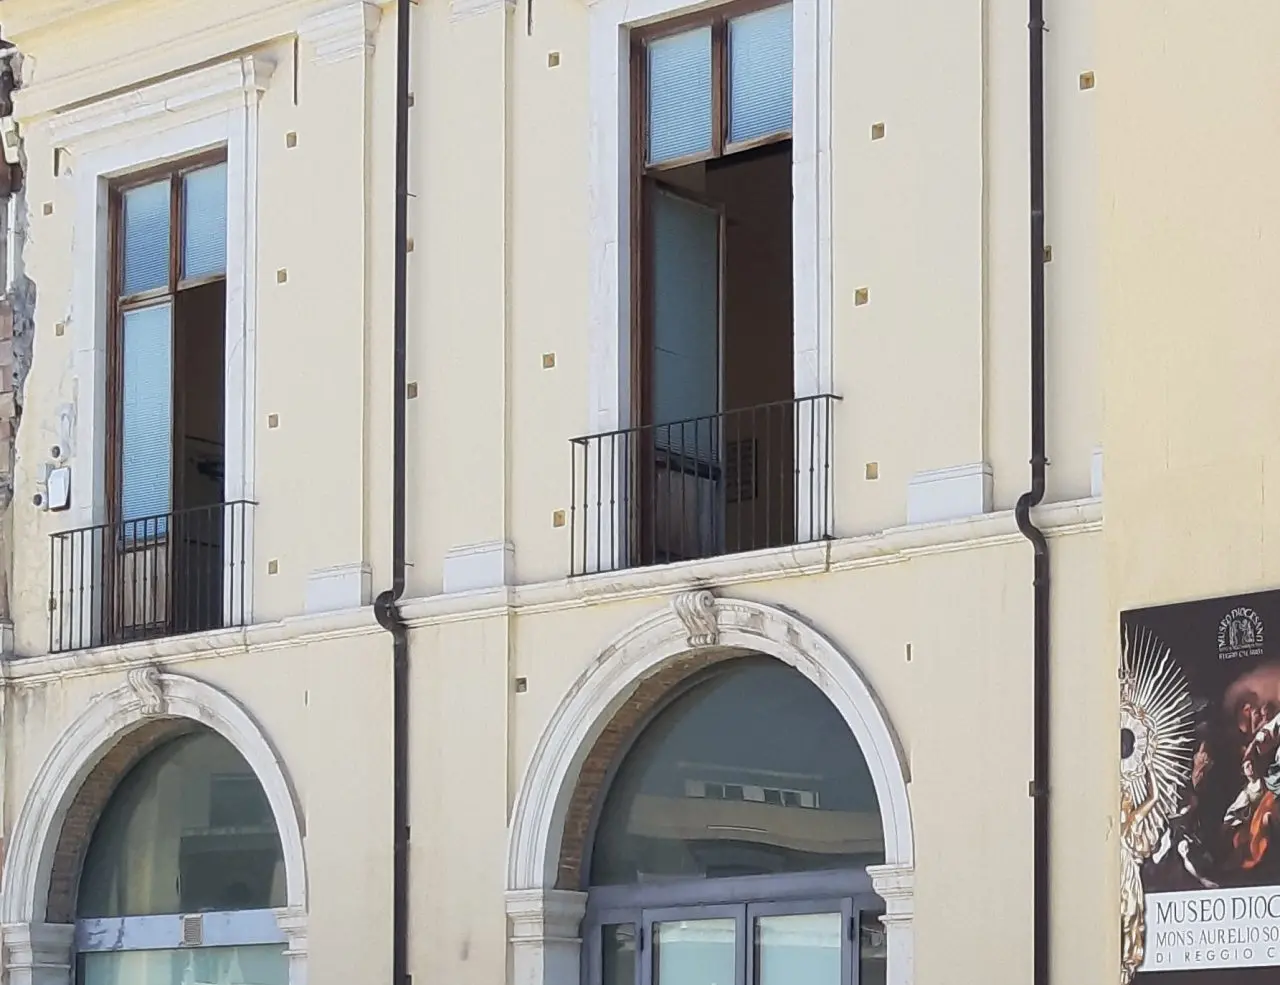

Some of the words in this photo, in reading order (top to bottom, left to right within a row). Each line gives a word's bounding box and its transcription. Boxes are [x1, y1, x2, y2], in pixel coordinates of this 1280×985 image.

[1217, 614, 1232, 648] MUSEO
[1156, 898, 1226, 925] MUSEO
[1199, 927, 1260, 945] AURELIO
[1156, 952, 1172, 964] DI
[1184, 947, 1253, 962] REGGIO
